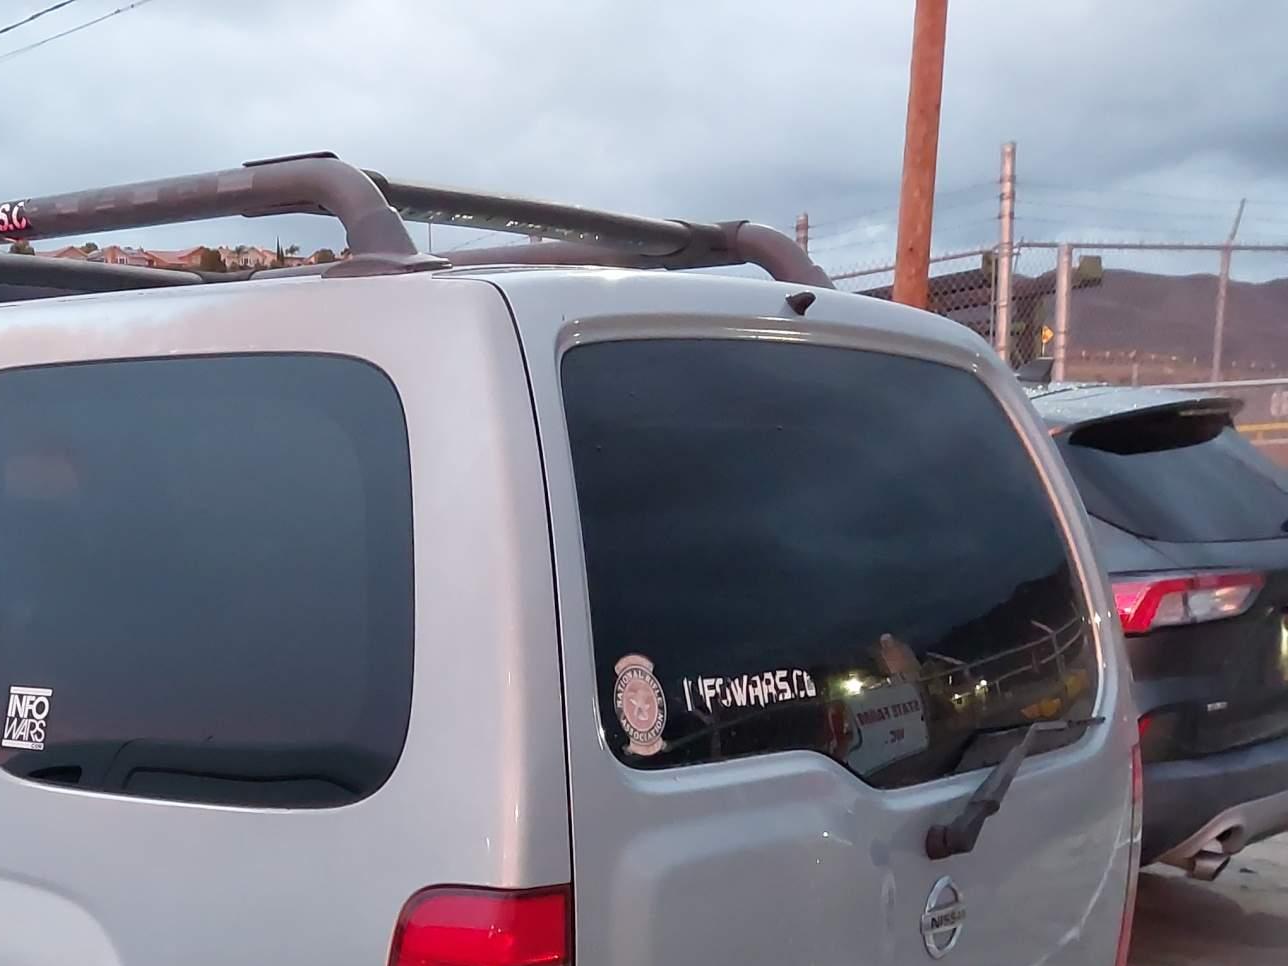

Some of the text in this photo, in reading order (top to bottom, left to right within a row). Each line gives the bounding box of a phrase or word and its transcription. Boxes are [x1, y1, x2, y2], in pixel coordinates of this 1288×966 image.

[616, 669, 664, 708] NATIONAL RIFLE
[7, 694, 50, 720] INFO
[4, 717, 47, 742] WARS
[621, 713, 664, 742] ASSOCIATION
